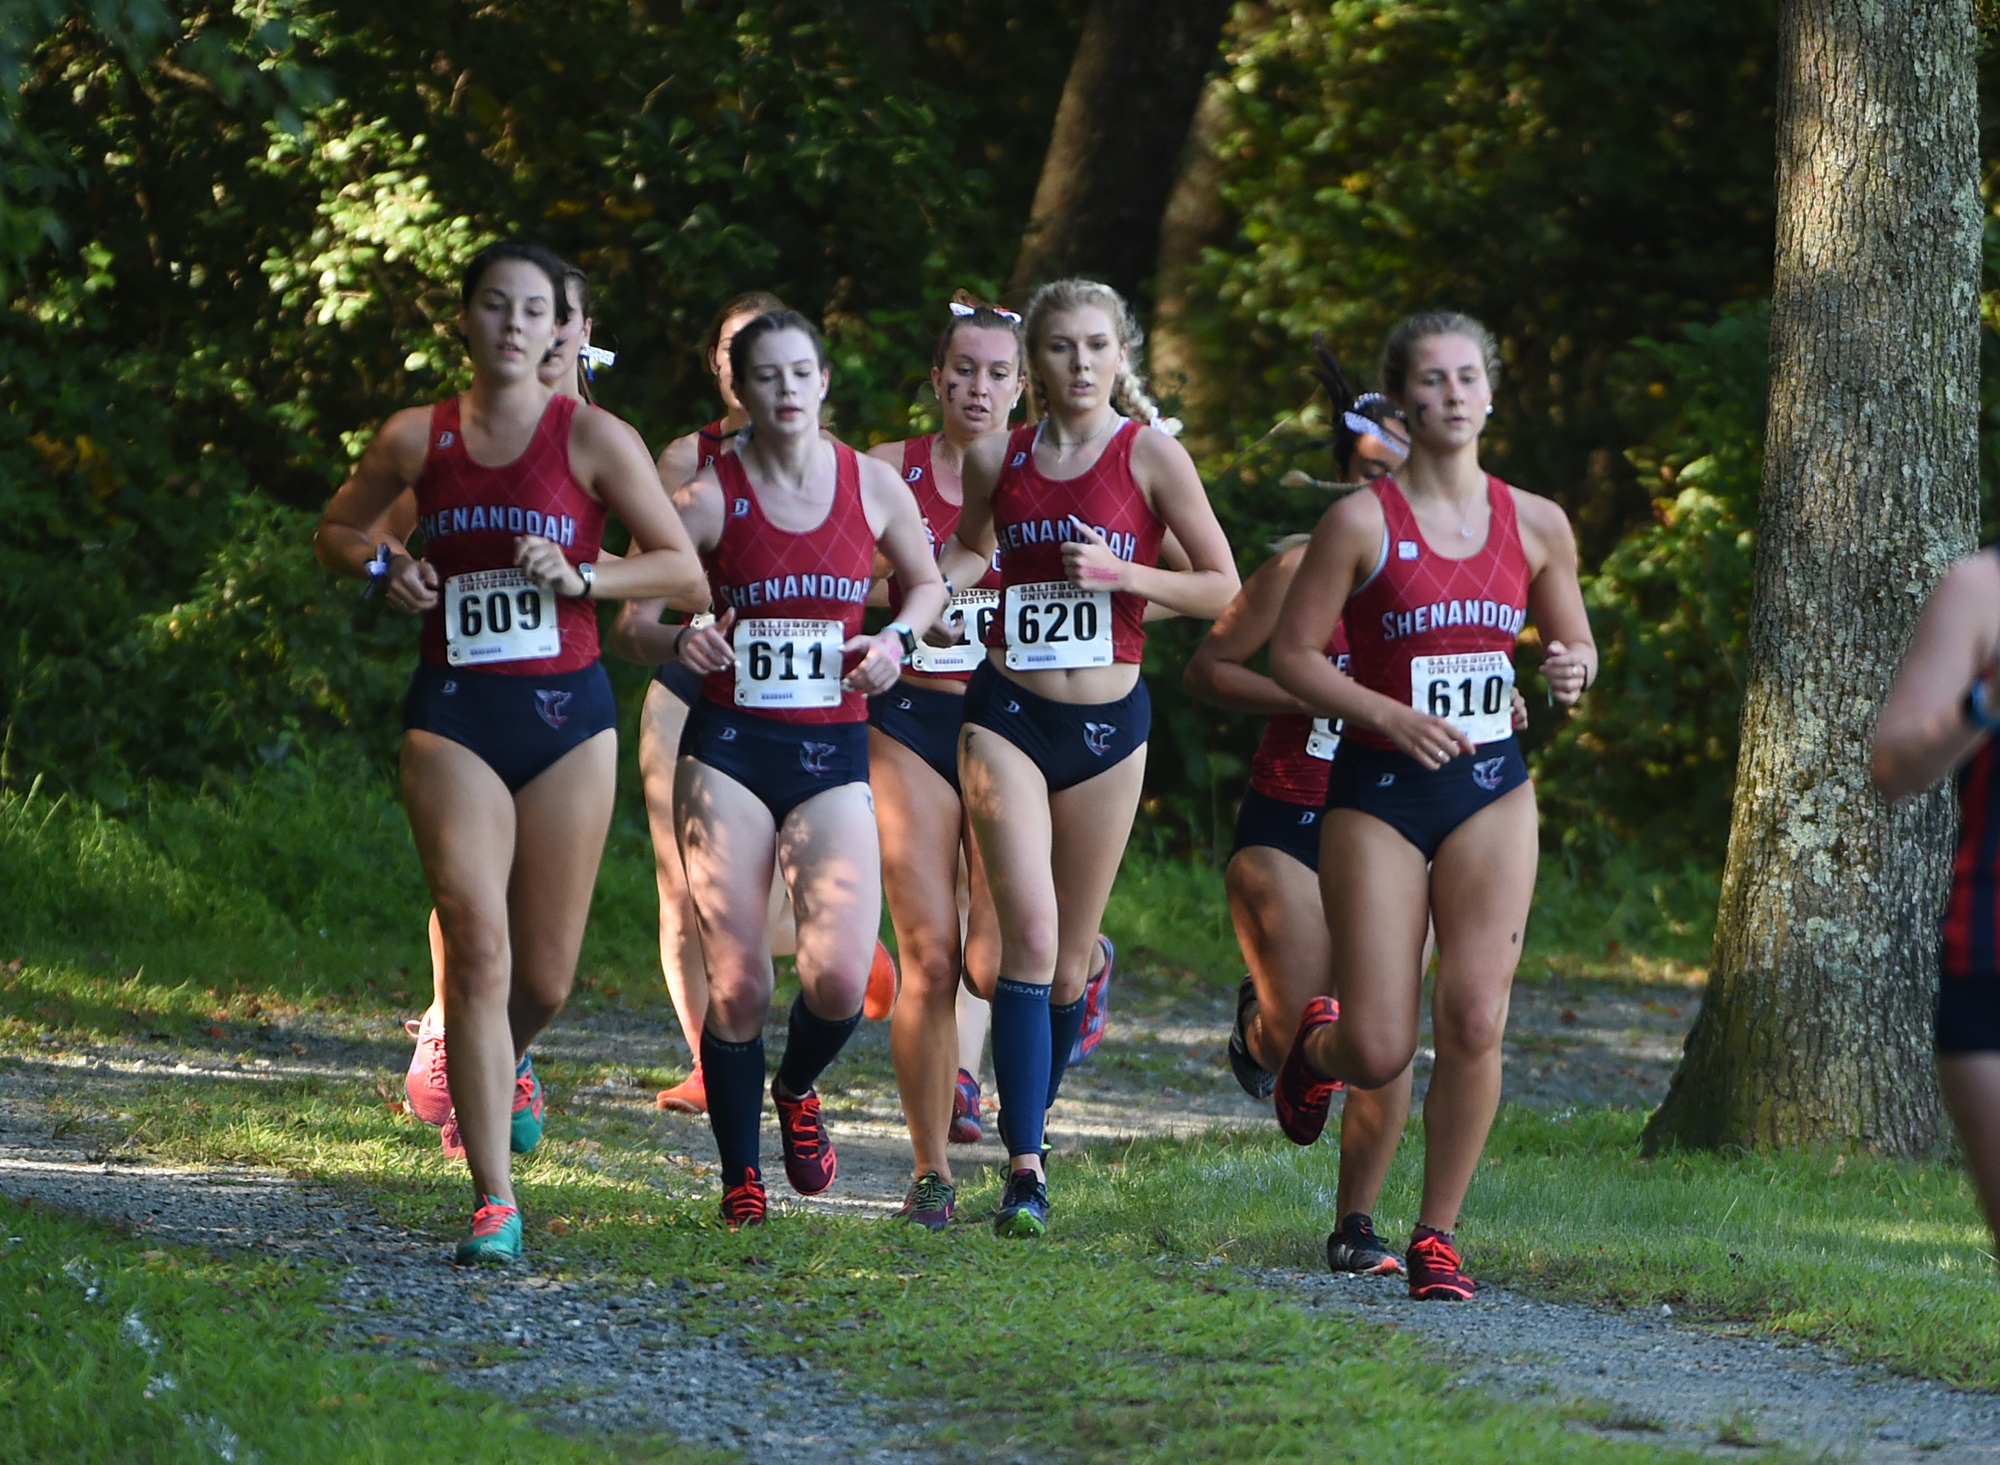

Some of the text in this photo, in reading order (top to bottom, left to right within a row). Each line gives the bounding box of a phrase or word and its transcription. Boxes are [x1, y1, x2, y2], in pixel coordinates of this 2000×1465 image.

[420, 505, 575, 547] HENANDOAH
[459, 588, 541, 636] 609
[952, 595, 996, 606] ERSITY
[1018, 601, 1097, 644] 620
[748, 640, 825, 681] 611
[1428, 675, 1503, 718] 610
